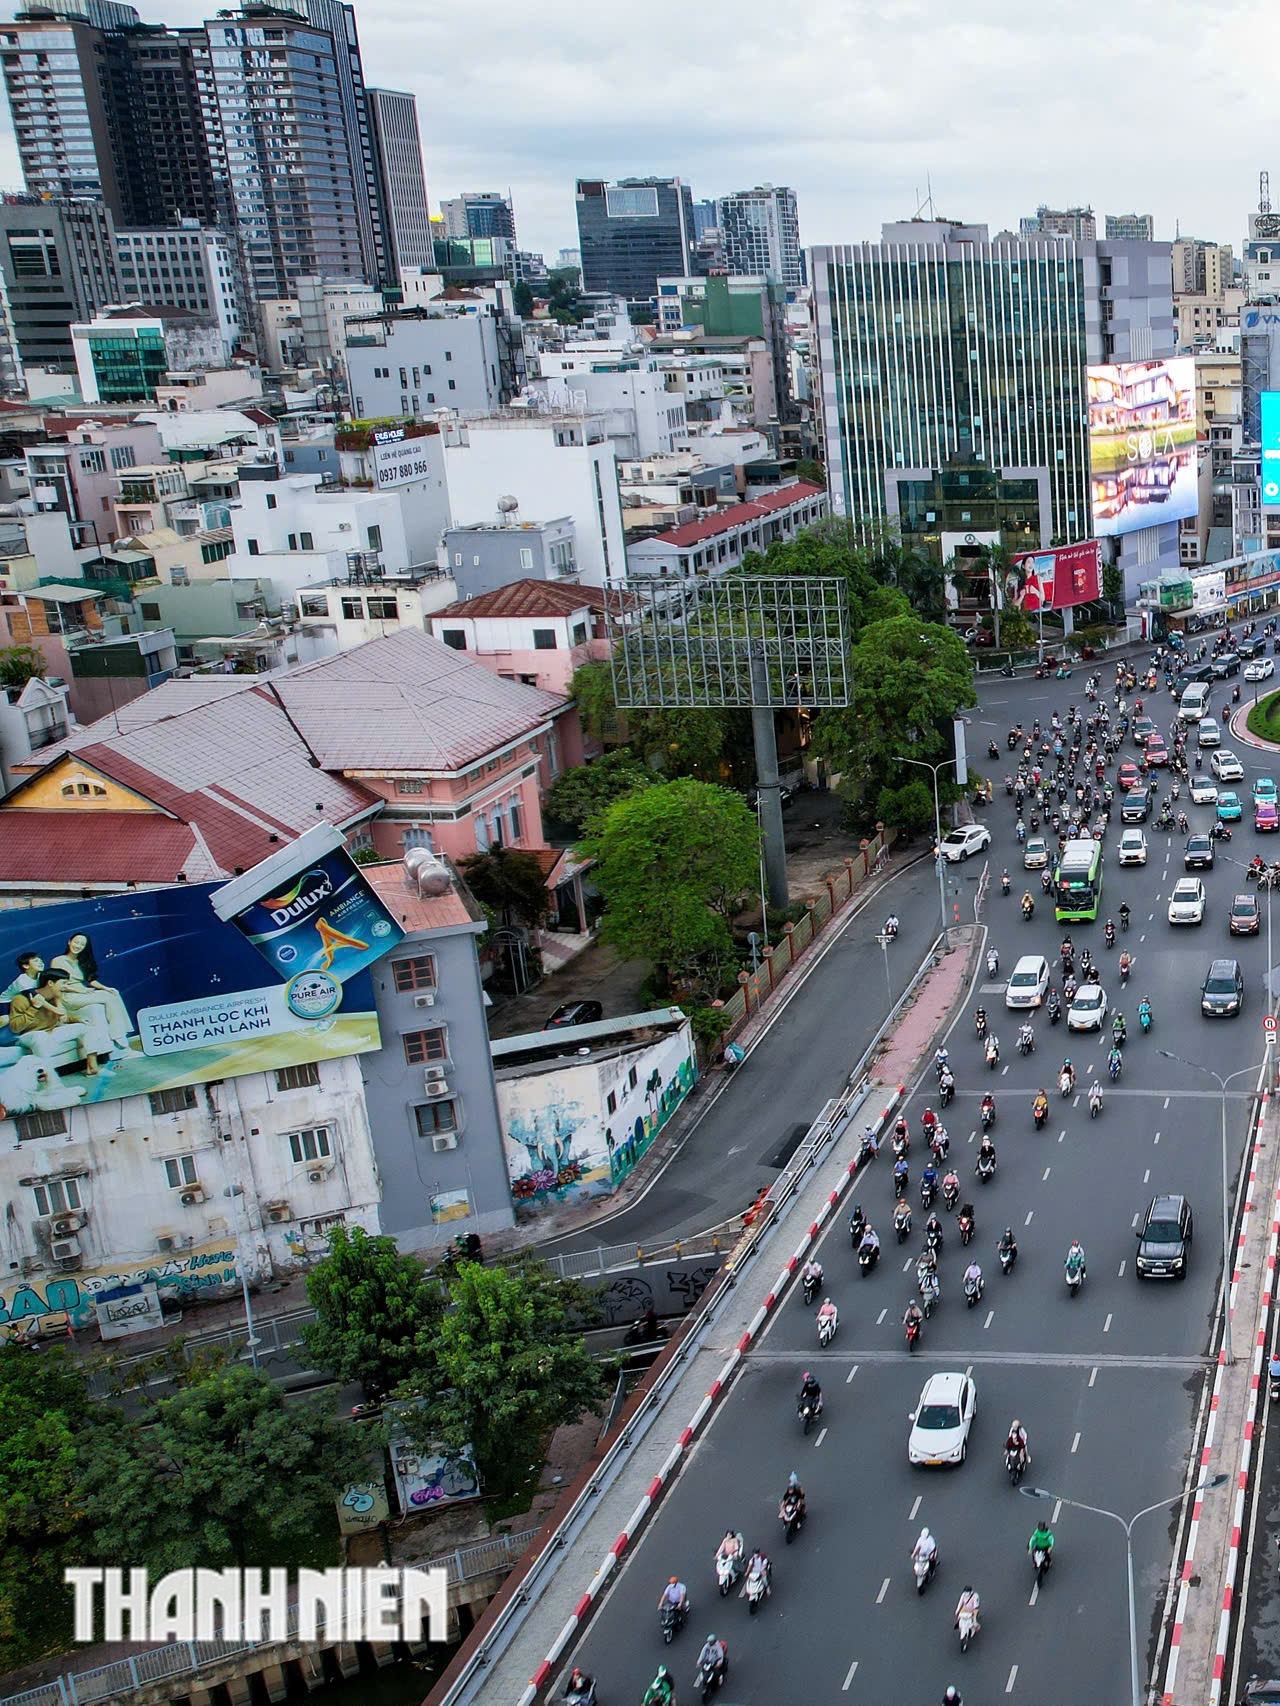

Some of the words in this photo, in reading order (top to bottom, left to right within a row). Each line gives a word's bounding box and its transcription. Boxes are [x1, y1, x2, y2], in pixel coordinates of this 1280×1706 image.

[388, 429, 405, 438] HOUSE
[1127, 430, 1176, 461] SOLA
[379, 467, 397, 483] 0937
[399, 463, 413, 478] 880
[414, 460, 428, 475] 966
[270, 885, 332, 927] Dulux
[329, 891, 365, 918] AMBIANCE
[290, 988, 316, 1001] PURE
[319, 986, 336, 996] AIR
[148, 1011, 178, 1022] DULUX
[180, 1003, 224, 1016] AMBIANCE
[226, 996, 267, 1008] AIRFRESH
[150, 1016, 205, 1034] THANH
[209, 1010, 240, 1024] LỌC
[244, 1004, 269, 1018] KHÍ
[203, 1026, 225, 1038] AN
